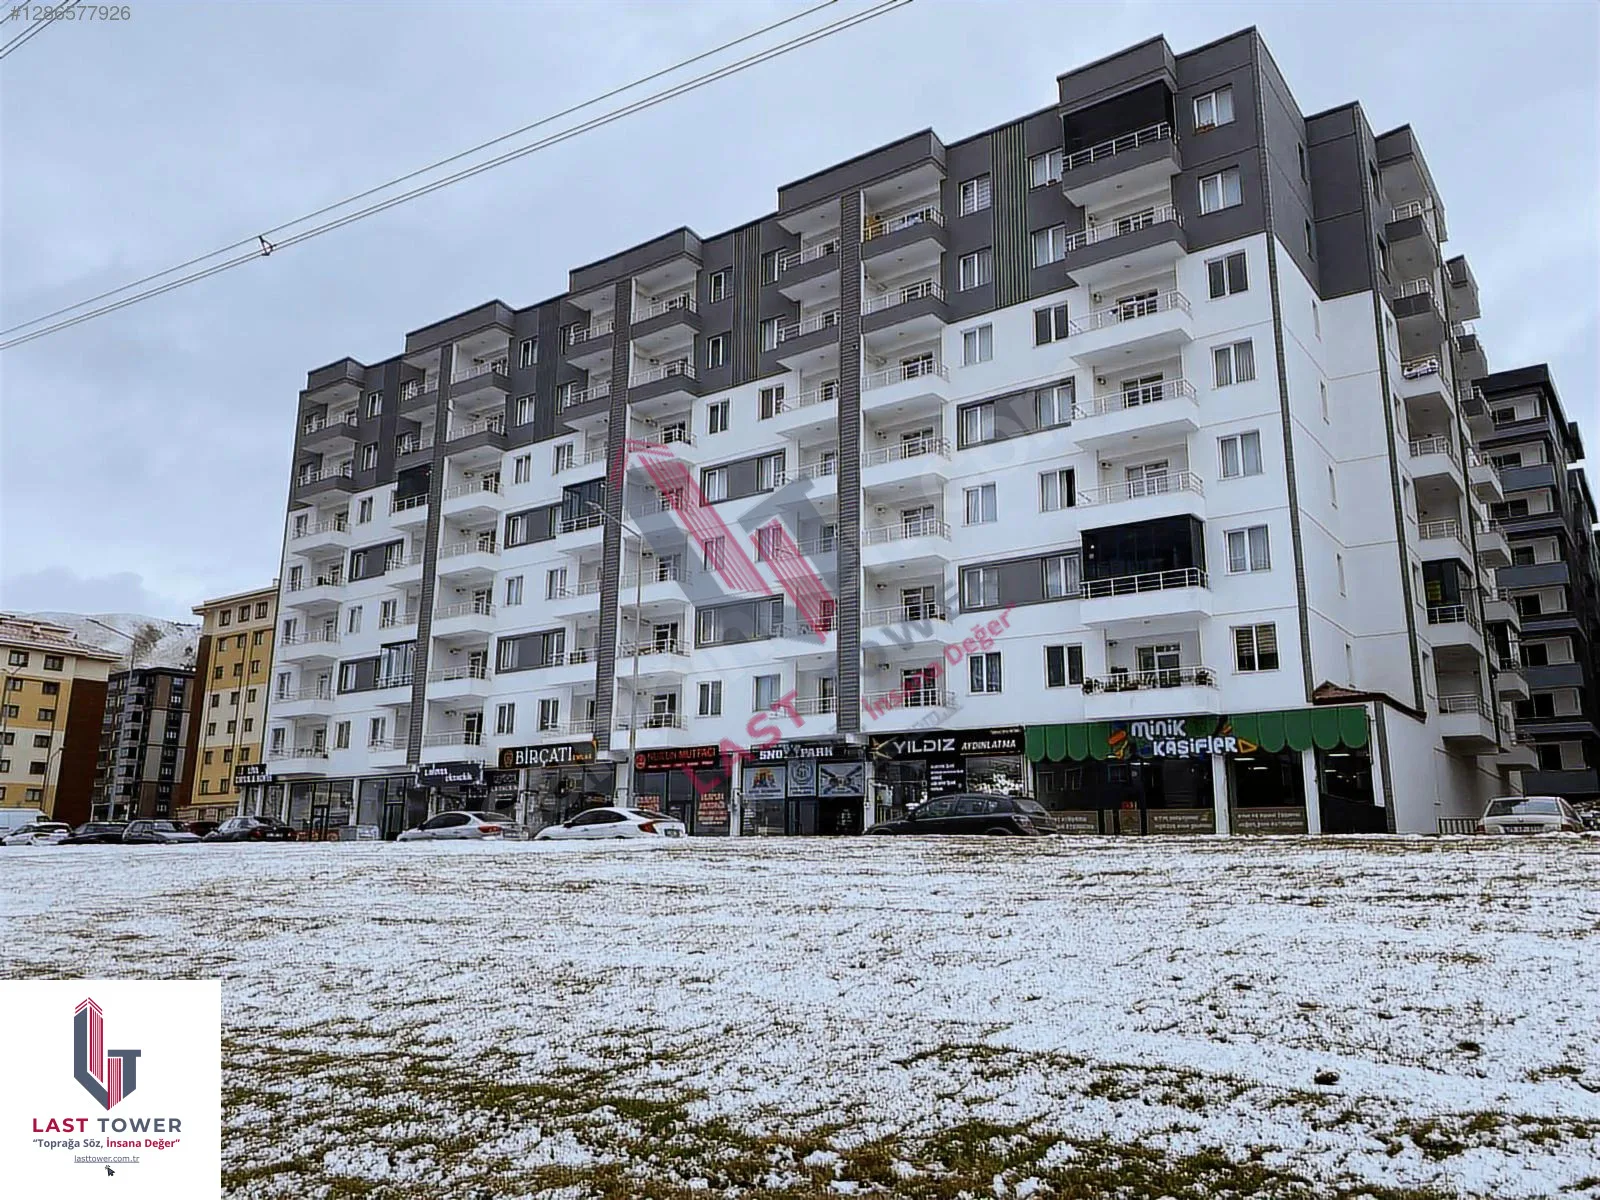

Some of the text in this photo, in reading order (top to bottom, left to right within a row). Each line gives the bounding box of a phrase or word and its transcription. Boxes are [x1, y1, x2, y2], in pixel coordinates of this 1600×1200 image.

[892, 738, 1017, 755] YILDIZ AYDINLATMA
[515, 746, 573, 767] BİRÇATI
